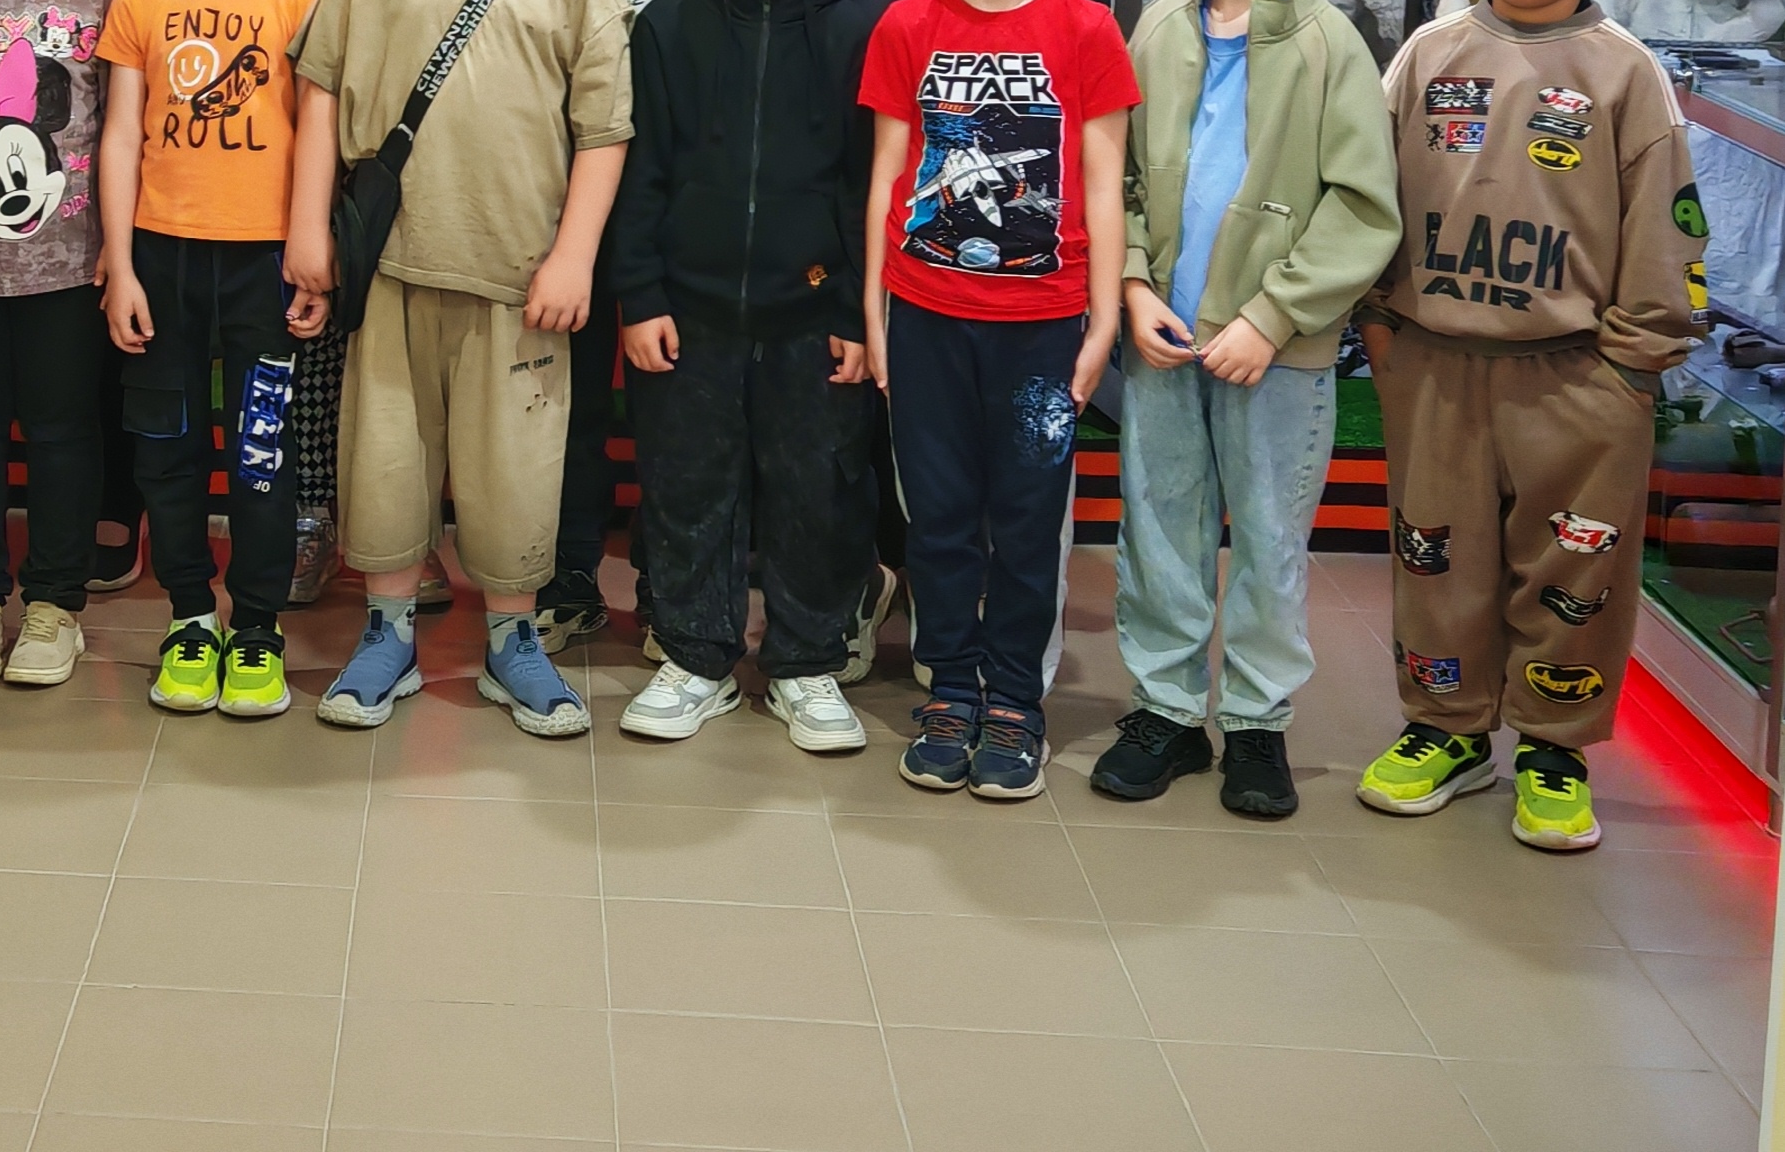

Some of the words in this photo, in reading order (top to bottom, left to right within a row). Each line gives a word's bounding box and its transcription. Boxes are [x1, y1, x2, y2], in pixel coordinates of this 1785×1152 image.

[165, 8, 264, 45] ENJOY
[928, 52, 1051, 76] SPACE
[917, 73, 1060, 102] ATTACK
[162, 112, 267, 151] ROLL
[1421, 276, 1533, 312] AIR
